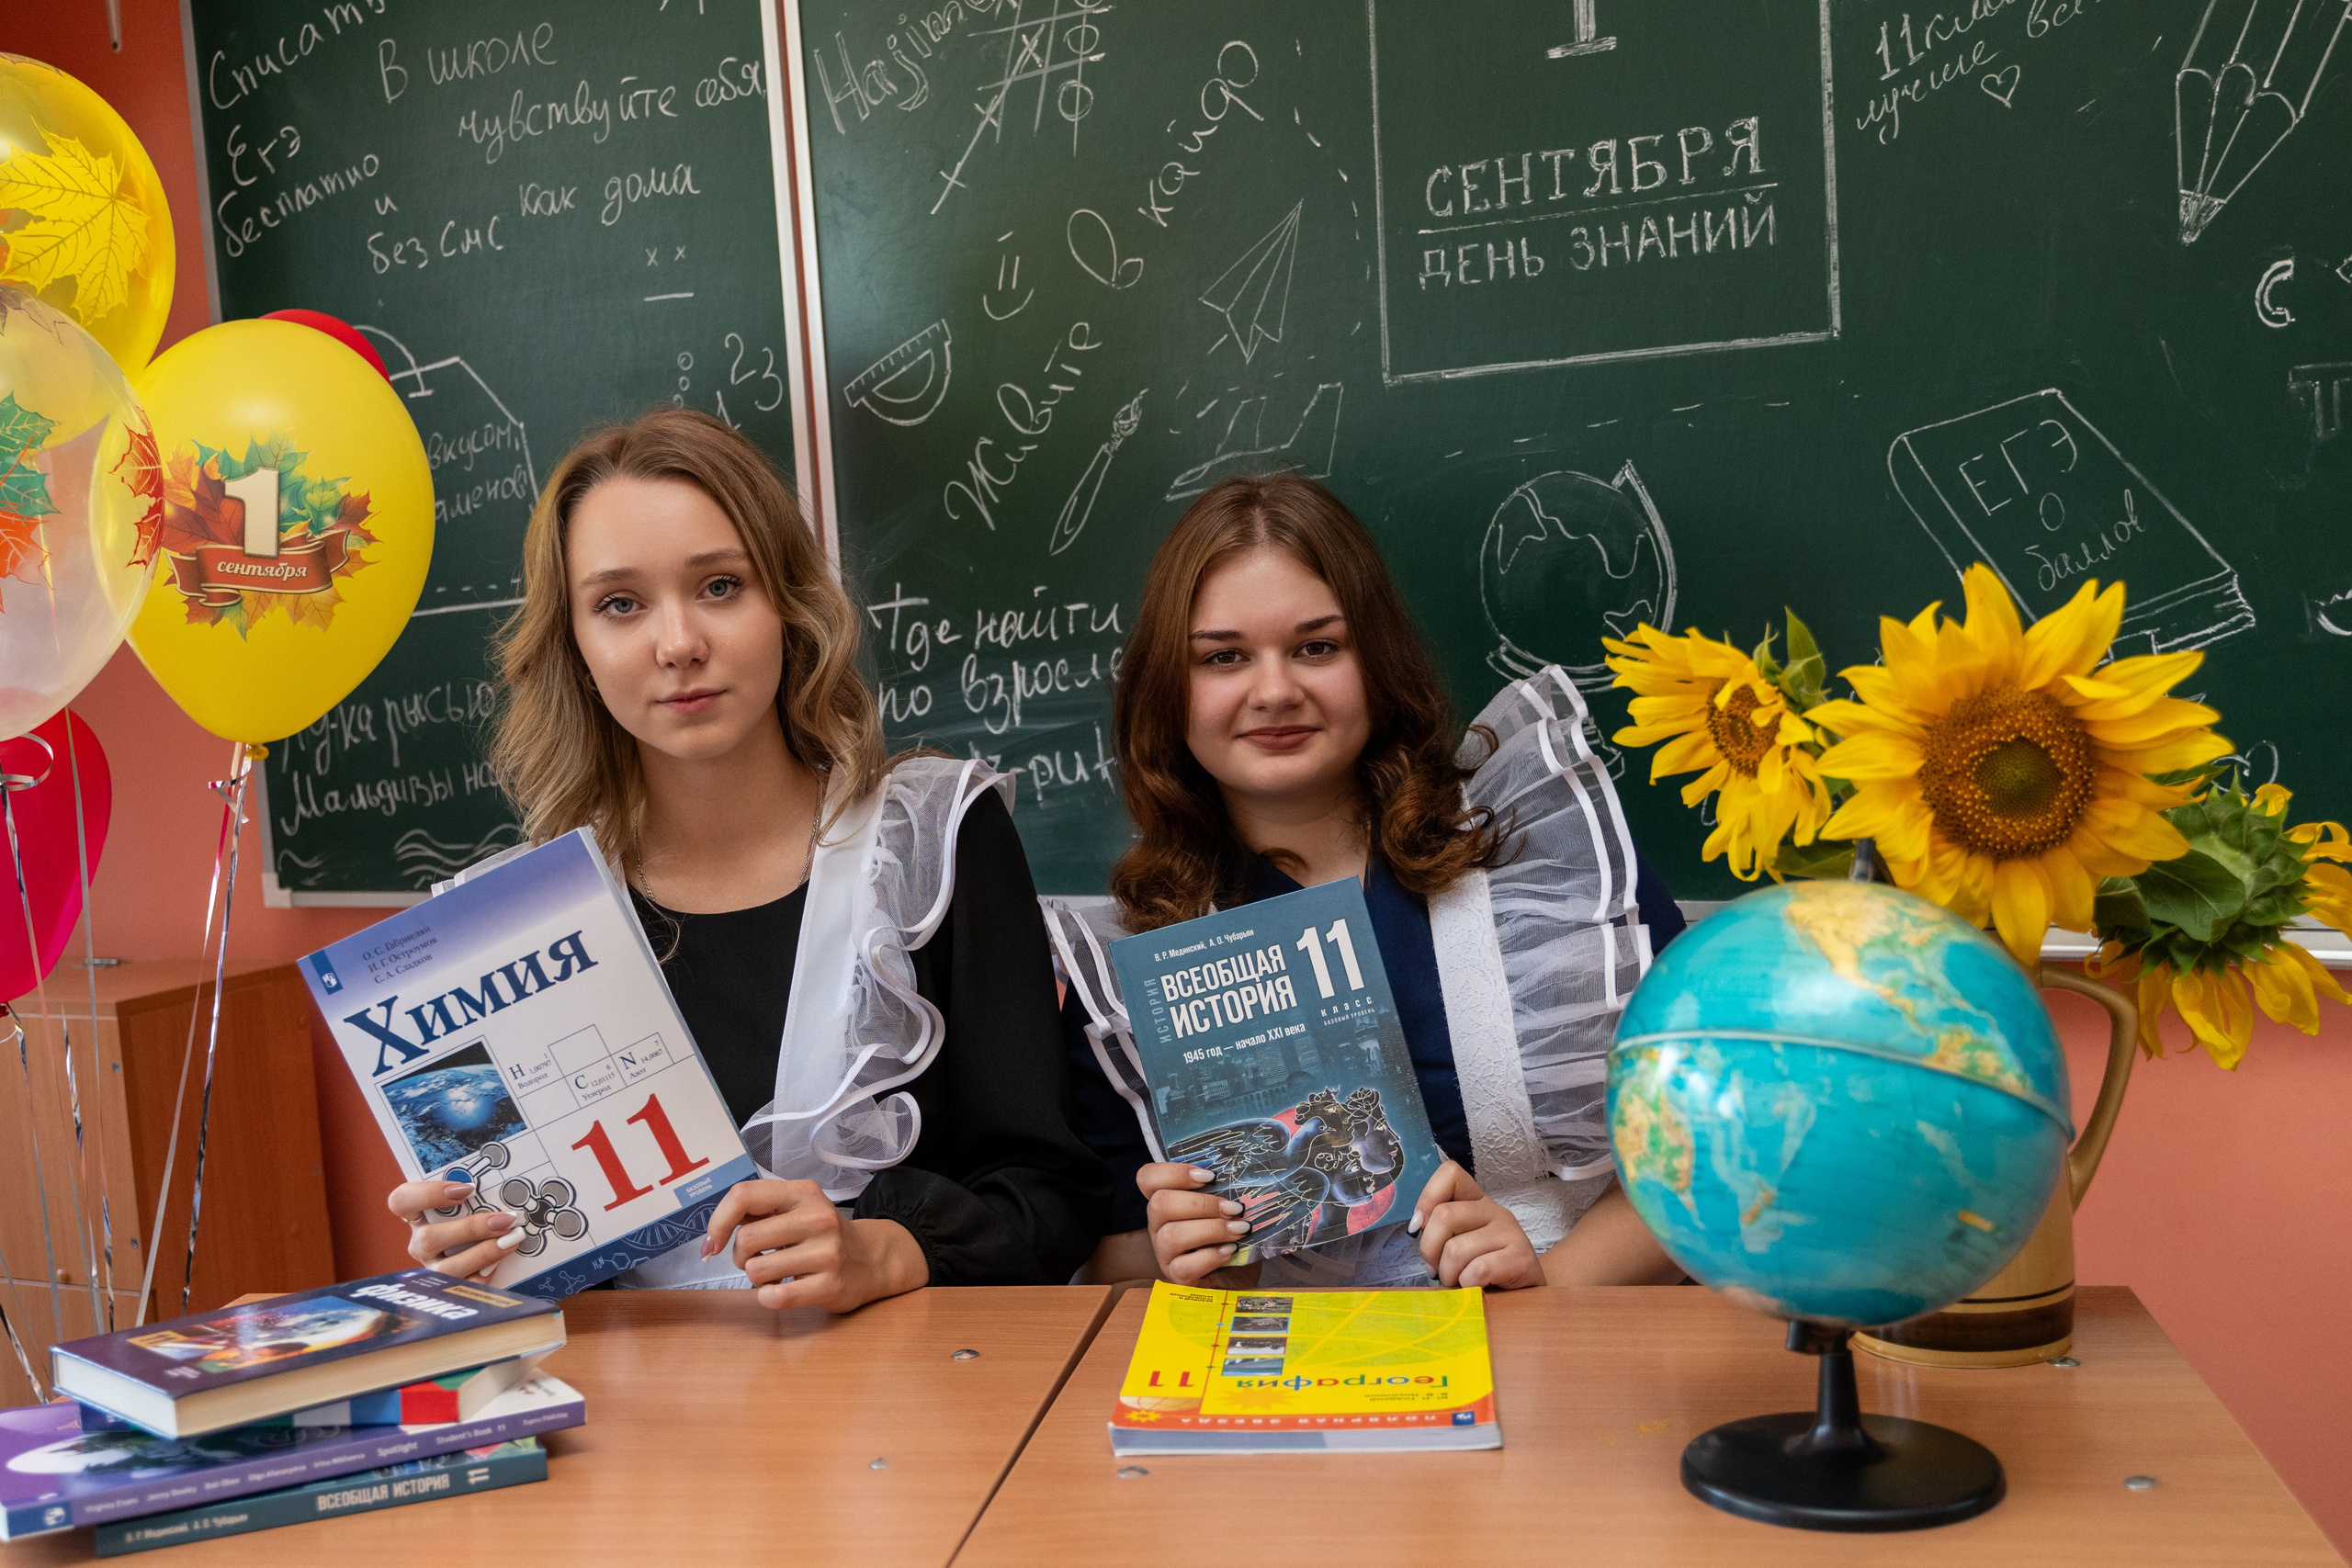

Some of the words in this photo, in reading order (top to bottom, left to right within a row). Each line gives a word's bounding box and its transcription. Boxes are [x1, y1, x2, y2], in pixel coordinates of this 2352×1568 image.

[428, 22, 559, 86] школе
[458, 75, 679, 164] чувствуйте
[1425, 116, 1767, 218] СЕНТЯБРЯ
[520, 184, 578, 217] как
[605, 164, 701, 226] дома
[368, 231, 429, 275] без
[1418, 236, 1544, 290] ДЕНЬ
[1569, 189, 1776, 271] ЗНАНИЙ
[1959, 418, 2077, 516] ЕГЭ
[224, 467, 279, 558] 1
[2024, 488, 2146, 592] баллов
[216, 558, 309, 582] сентября
[974, 585, 1123, 650] найти
[279, 768, 455, 837] Мальдивы
[362, 952, 375, 961] О.
[375, 946, 385, 955] С.
[384, 926, 432, 952] Габриелян
[380, 958, 389, 967] Г.
[389, 937, 437, 963] Остроумов
[1154, 953, 1162, 962] В.
[1162, 951, 1169, 960] Р.
[1168, 941, 1207, 958] Мединский,
[1209, 938, 1216, 947] А.
[1216, 935, 1225, 945] О.
[1224, 929, 1255, 943] Чубарьян
[1295, 919, 1364, 999] 11
[375, 975, 386, 984] С.
[386, 970, 395, 979] А.
[395, 954, 433, 974] Сладков
[1159, 944, 1286, 1002] ВСЕОБЩАЯ
[1143, 978, 1172, 1043] ИСТОРИЯ
[1169, 975, 1298, 1039] ИСТОРИЯ
[1323, 1013, 1350, 1026] БАЗОВЫЙ
[1351, 1007, 1375, 1019] УРОВЕНЬ
[618, 1051, 638, 1070] N
[641, 1048, 663, 1064] 14,0067
[1182, 1048, 1204, 1064] 1945
[1206, 1045, 1223, 1058] год
[1235, 1033, 1267, 1050] начало
[1284, 1022, 1306, 1037] века
[517, 1072, 549, 1089] Водород
[528, 1059, 551, 1075] 1,00797
[629, 1067, 647, 1080] Азот
[582, 1084, 612, 1101] Углерод
[571, 1092, 711, 1213] 11
[1148, 1371, 1194, 1388] 11
[1237, 1374, 1448, 1392] География
[1298, 1415, 1436, 1424] ПОЛЯРНАЯ
[377, 1441, 419, 1458] Spotlight
[473, 1426, 493, 1438] Book
[316, 1483, 390, 1512] ВСЕОБЩАЯ
[392, 1472, 450, 1497] ИСТОРИЯ
[467, 1466, 490, 1485] 11
